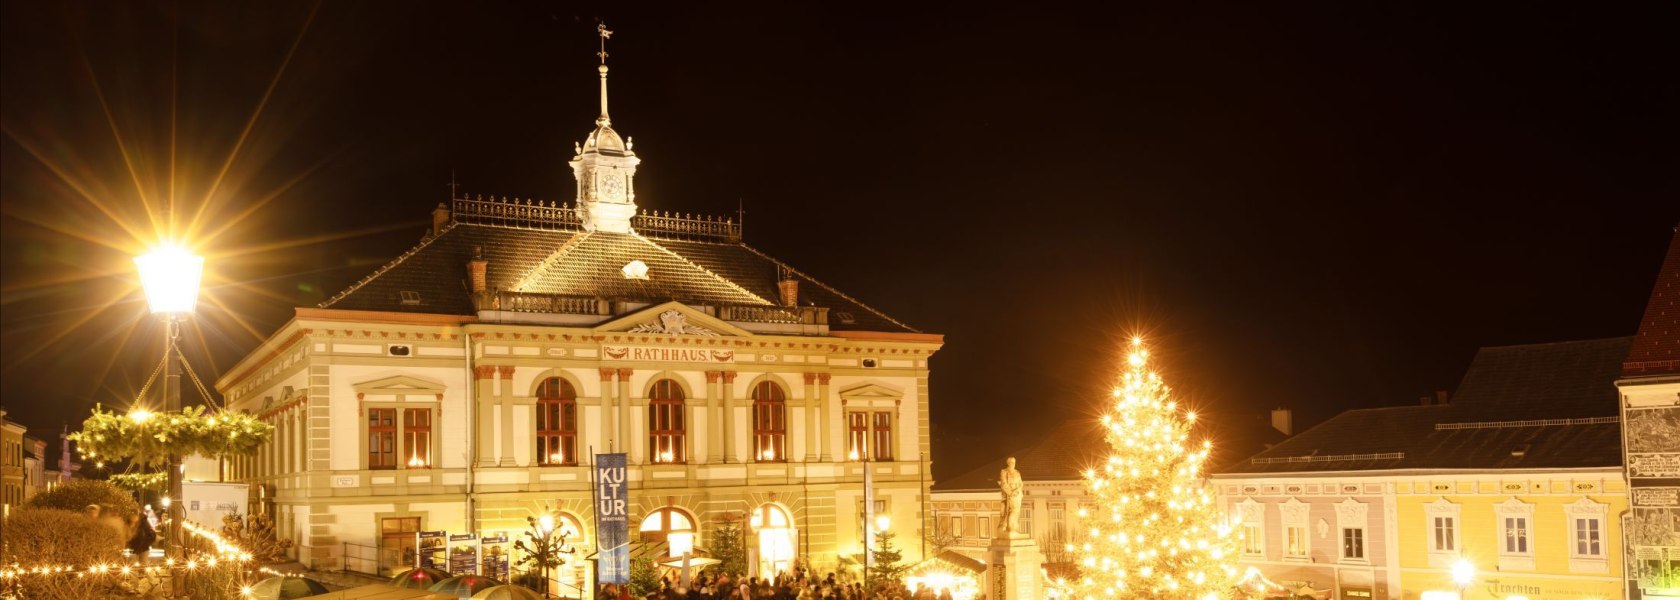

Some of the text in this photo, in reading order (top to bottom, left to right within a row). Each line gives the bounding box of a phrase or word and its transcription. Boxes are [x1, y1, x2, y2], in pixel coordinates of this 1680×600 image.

[600, 467, 625, 484] KU
[600, 483, 620, 500] LT
[600, 499, 626, 516] UR
[1485, 579, 1541, 599] Trachten
